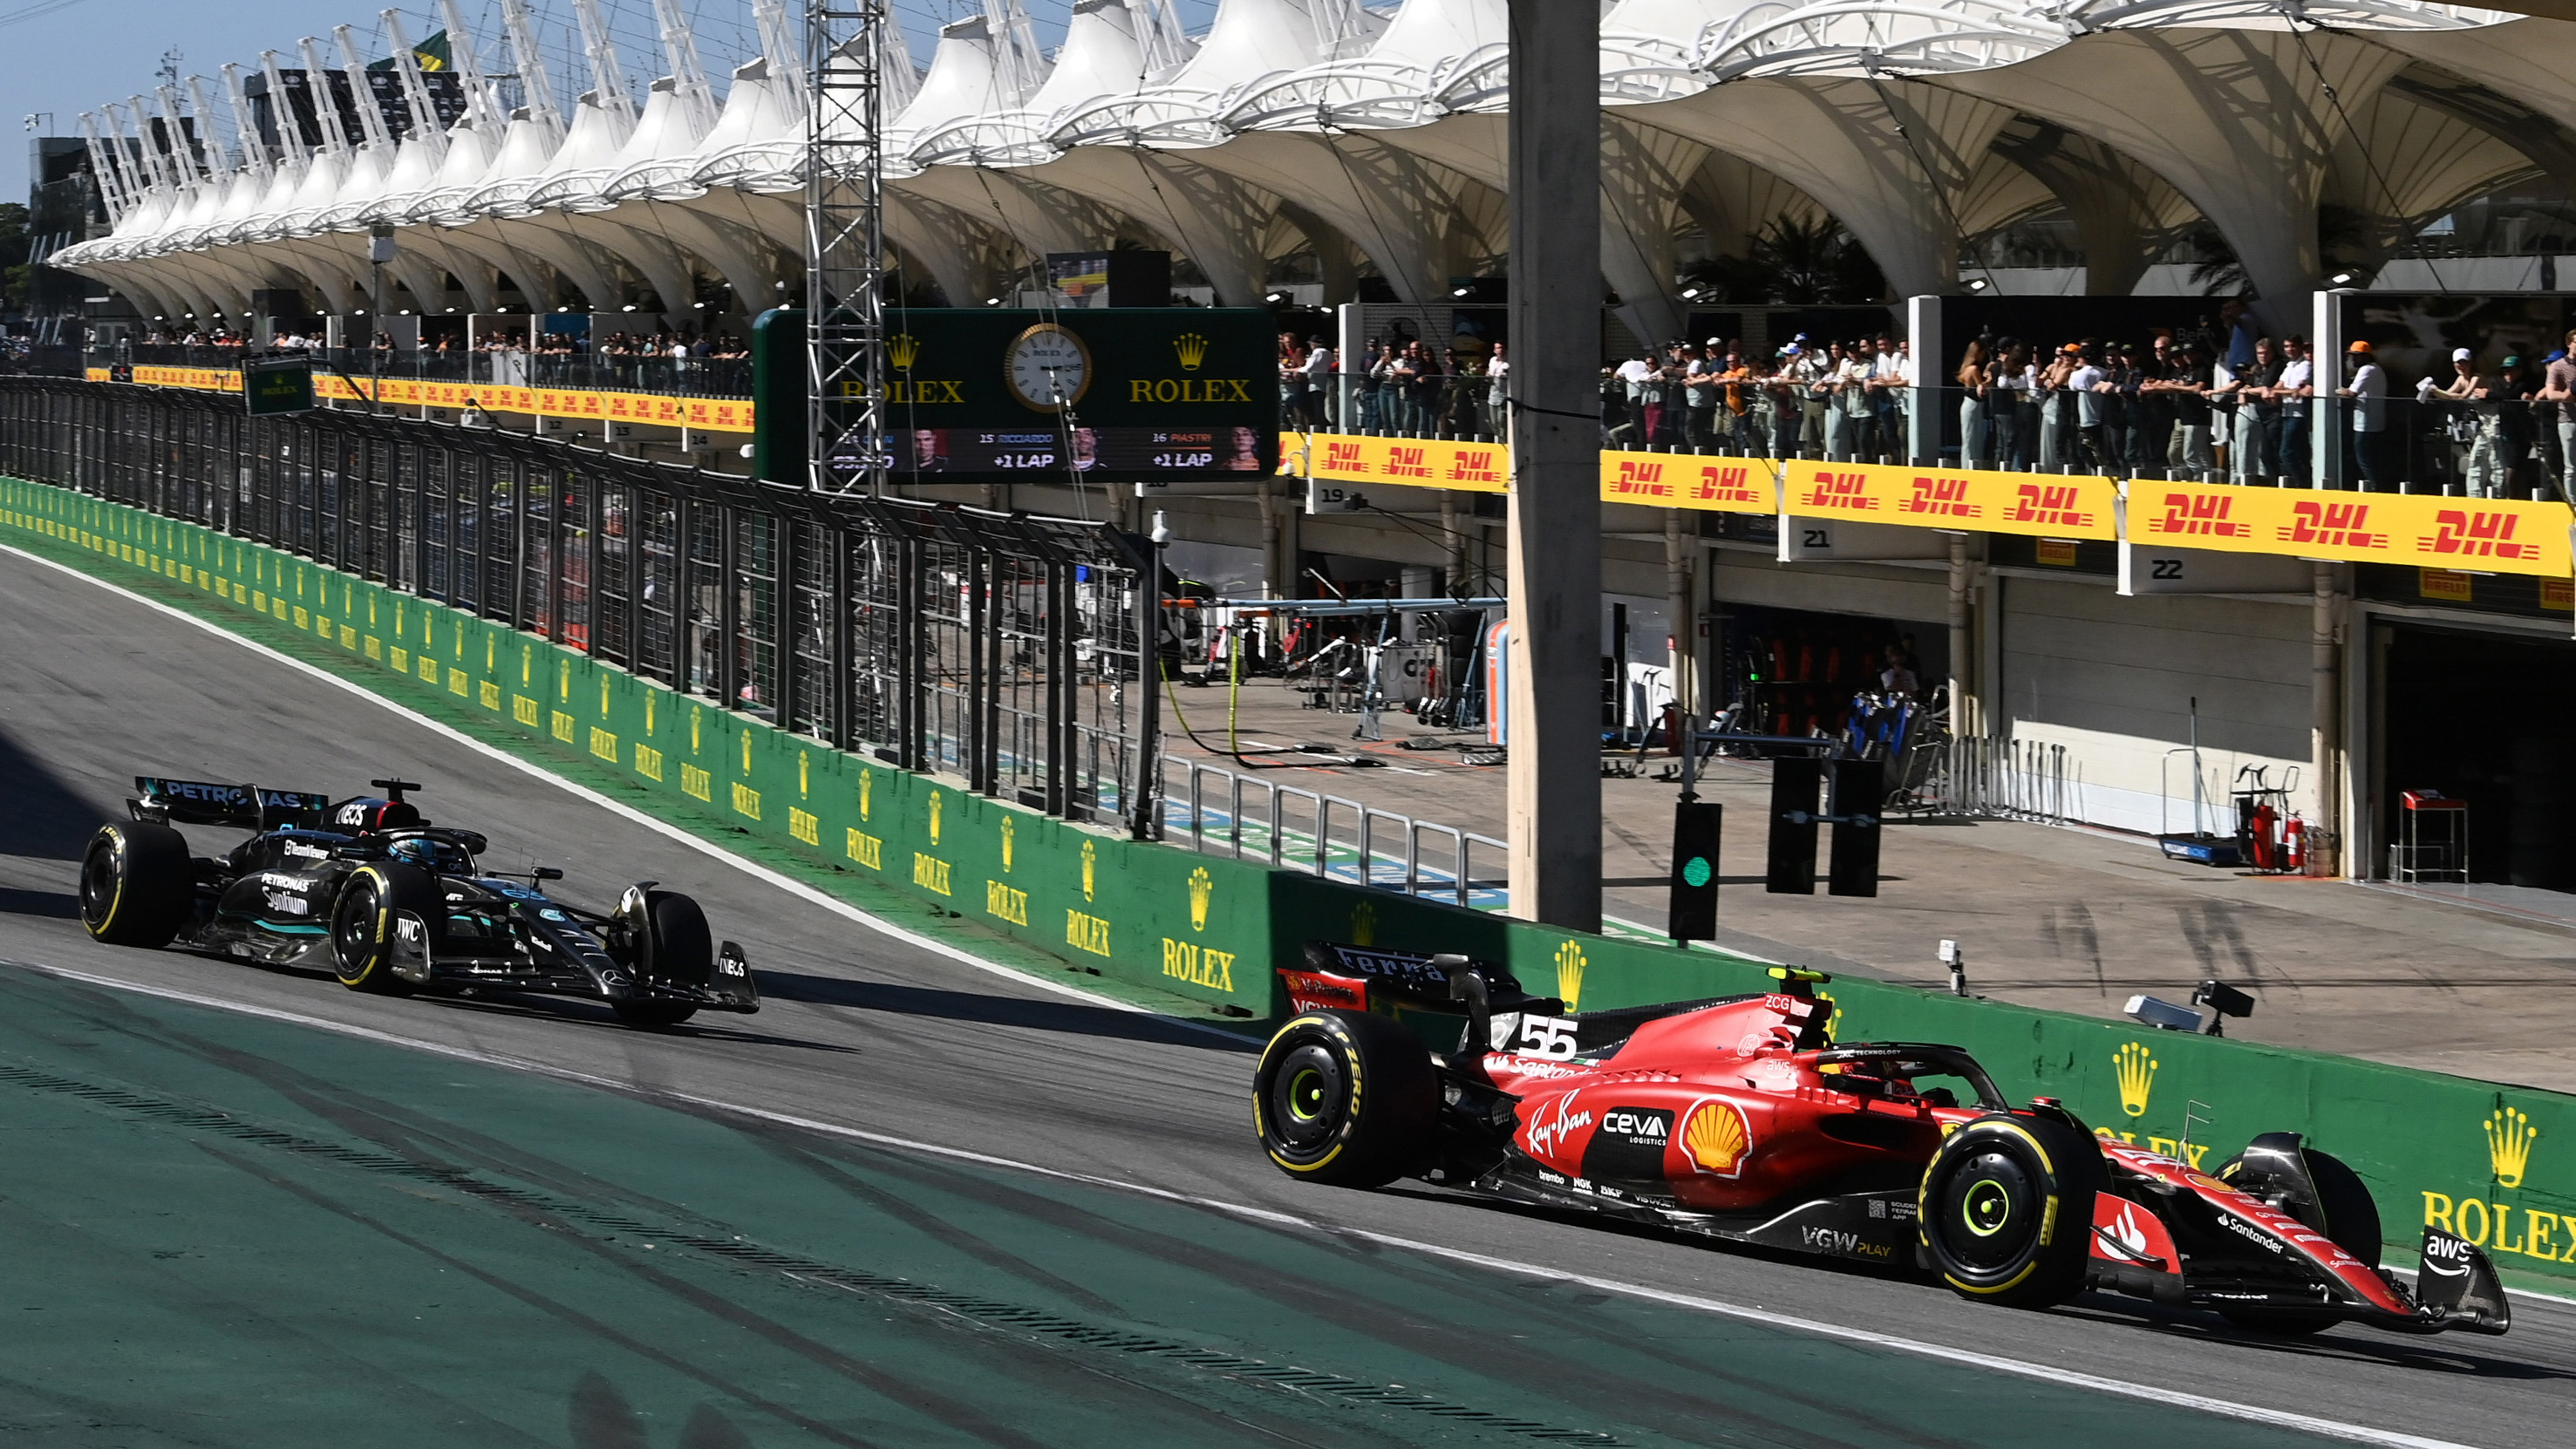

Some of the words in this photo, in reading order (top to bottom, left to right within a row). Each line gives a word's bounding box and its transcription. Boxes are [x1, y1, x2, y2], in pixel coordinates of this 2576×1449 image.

[1129, 379, 1253, 403] ROLEX
[549, 420, 563, 430] 12
[615, 426, 630, 437] 13
[1152, 433, 1168, 442] 16
[692, 435, 708, 446] 14
[994, 454, 1013, 468] +1
[1016, 454, 1054, 468] LAP
[1153, 453, 1172, 466] +1
[1175, 453, 1213, 466] LAP
[1327, 443, 1362, 472] DHL
[1389, 447, 1425, 477] DHL
[1455, 452, 1493, 481] DHL
[1619, 462, 1665, 496] DHL
[1700, 466, 1749, 502] DHL
[1812, 472, 1870, 510] DHL
[1322, 489, 1345, 503] 19
[1910, 477, 1970, 517] DHL
[2015, 484, 2081, 527] DHL
[2163, 493, 2237, 537] DHL
[2292, 501, 2373, 548] DHL
[1803, 530, 1830, 548] 21
[2433, 510, 2523, 559] DHL
[2151, 560, 2184, 580] 22
[167, 781, 302, 808] PETROAS
[261, 873, 310, 893] PETRONAS
[262, 886, 309, 915] Syntium
[986, 880, 1028, 927] ROLEX
[397, 917, 421, 942] IWC
[1066, 908, 1111, 957] ROLEX
[1162, 937, 1236, 992] ROLEX
[1291, 997, 1334, 1014] VG
[1517, 1013, 1579, 1063] 55
[1335, 1031, 1351, 1043] P
[1345, 1047, 1362, 1116] ZERO
[1766, 1060, 1790, 1071] aws
[1629, 1137, 1667, 1146] LOGISTICS
[1538, 1169, 1565, 1186] brembo
[1572, 1176, 1593, 1191] NGK
[1802, 1224, 1859, 1252] VGW
[1857, 1242, 1891, 1258] PLAY
[2229, 1217, 2285, 1255] Santander
[2427, 1235, 2471, 1262] aws
